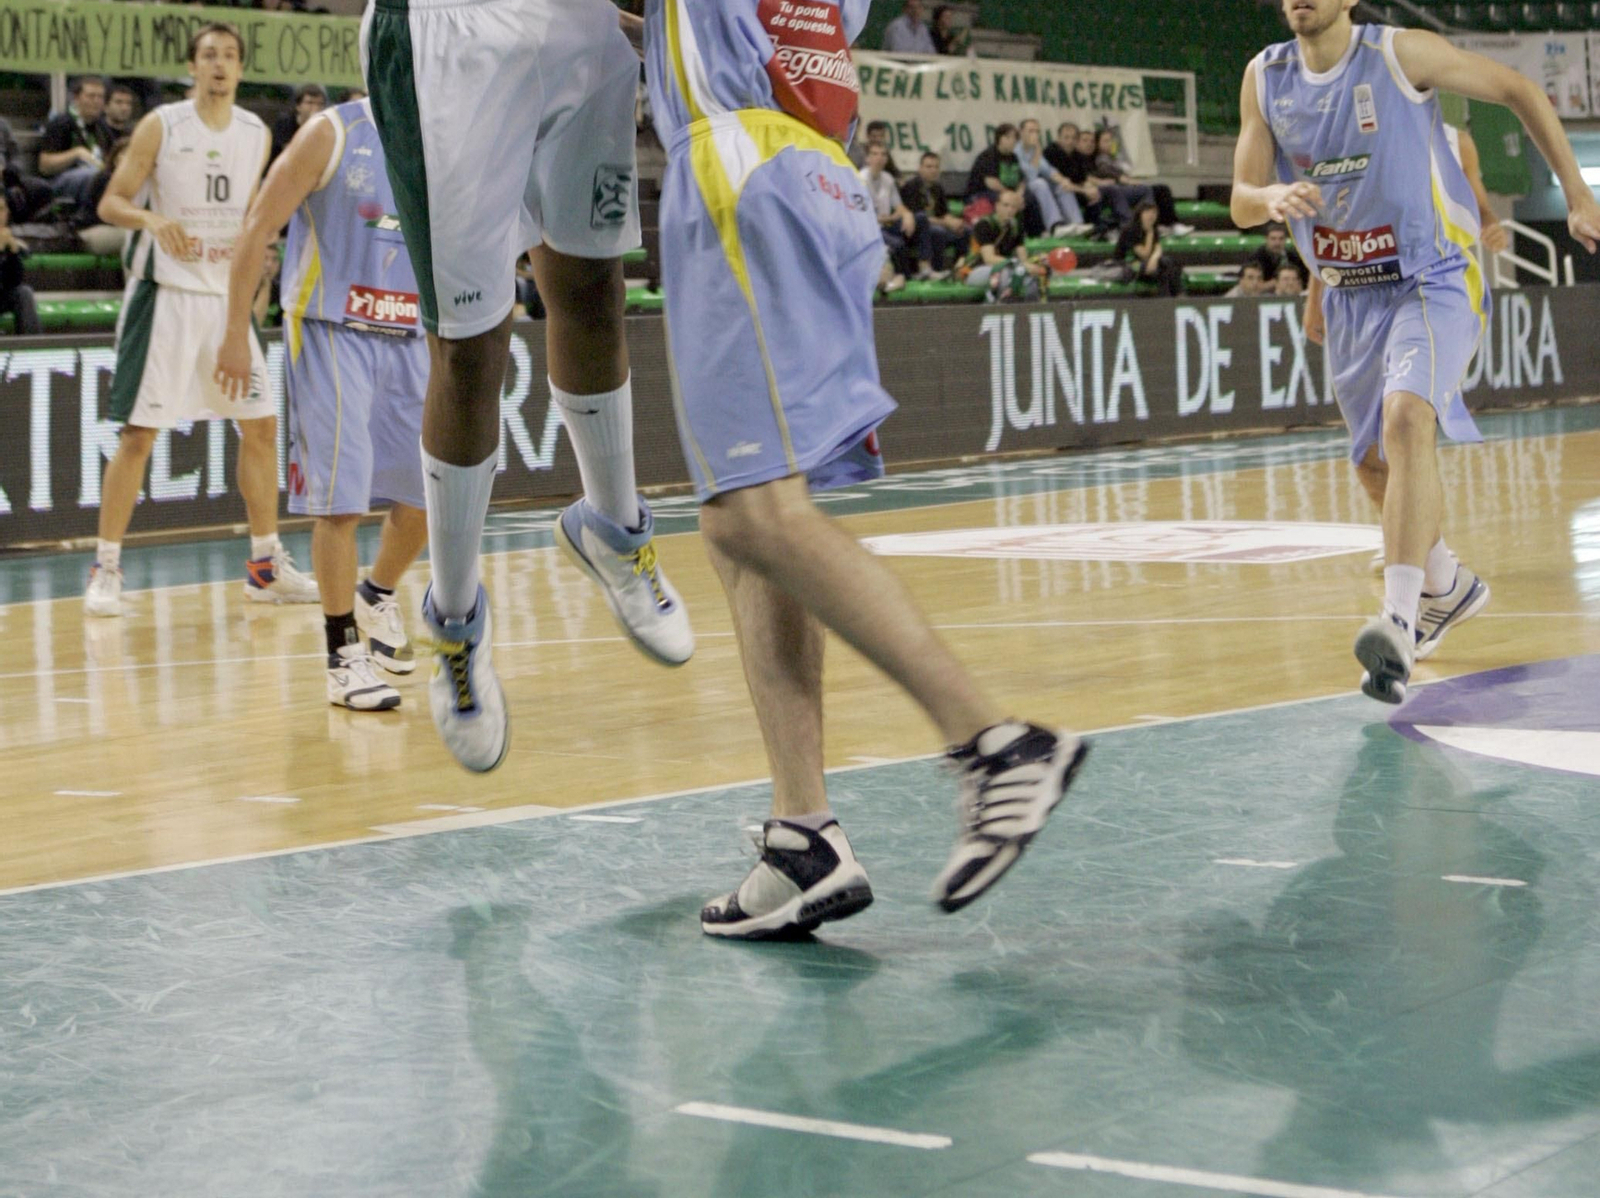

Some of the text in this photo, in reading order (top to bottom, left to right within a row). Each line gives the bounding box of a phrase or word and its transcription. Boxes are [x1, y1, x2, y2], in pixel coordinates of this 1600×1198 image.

[770, 14, 787, 26] de
[780, 1, 830, 20] Tu portal
[96, 13, 114, 68] Y
[120, 13, 145, 70] LA
[278, 24, 312, 75] OS
[319, 25, 361, 75] PAR
[945, 122, 973, 152] 10
[1311, 156, 1370, 177] farho
[206, 173, 230, 202] 10
[1339, 232, 1396, 262] gijón
[1340, 264, 1384, 277] DEPORTE
[1344, 272, 1400, 286] ASTURIANO
[374, 294, 418, 321] gijón
[979, 310, 1149, 452] JUNTA
[1176, 305, 1236, 417] DE
